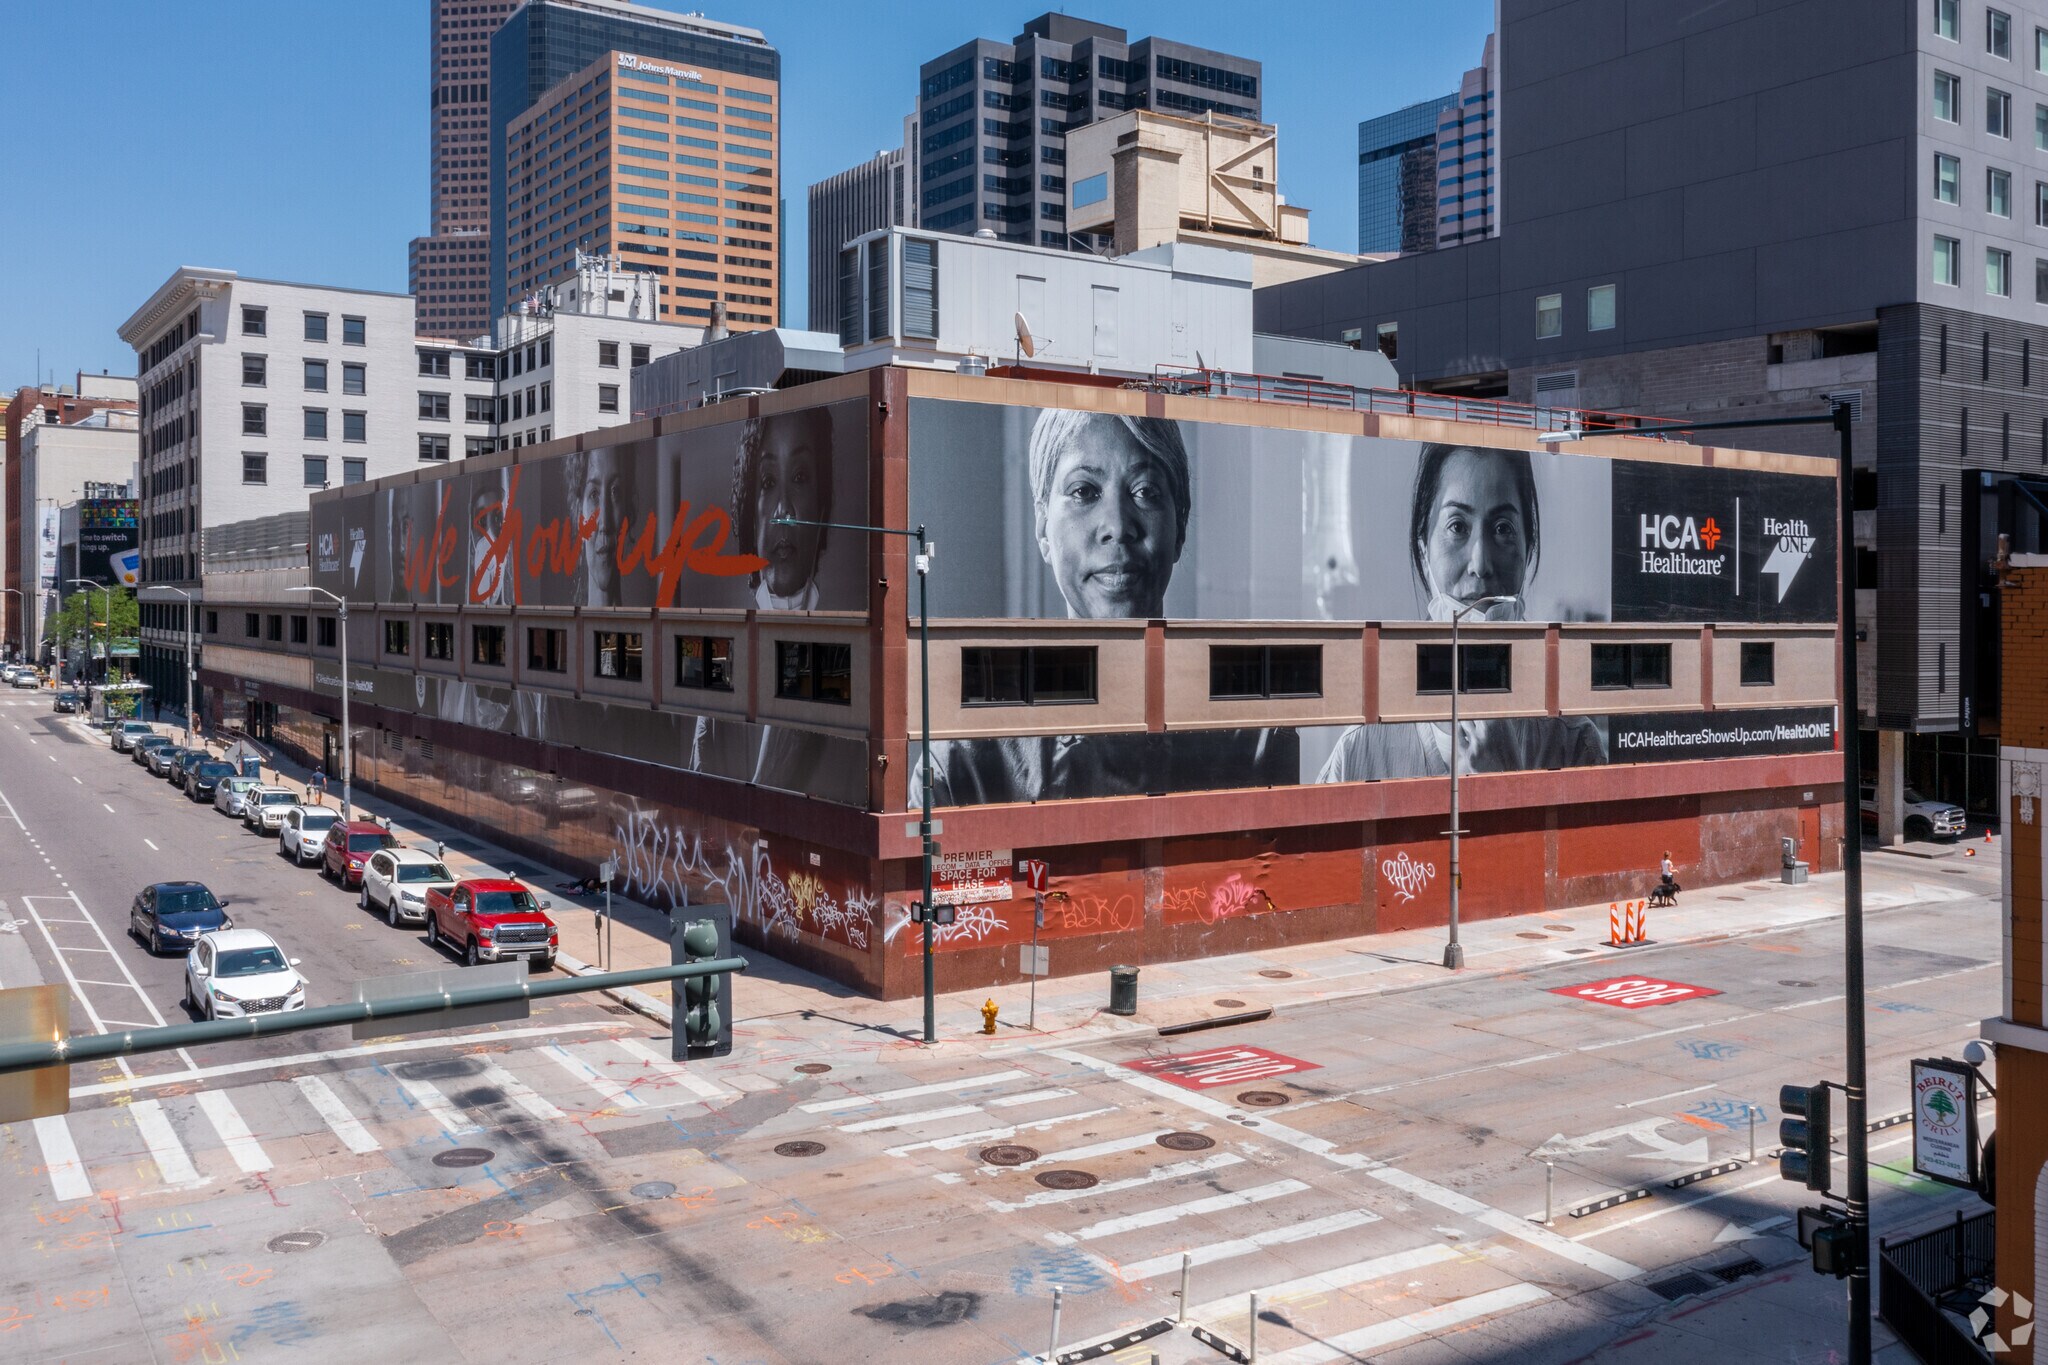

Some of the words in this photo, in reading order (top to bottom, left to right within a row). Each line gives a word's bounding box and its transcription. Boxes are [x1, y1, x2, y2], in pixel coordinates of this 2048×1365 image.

[638, 61, 664, 74] Johns
[665, 66, 702, 80] Manville
[1641, 514, 1700, 550] HCA
[1764, 518, 1809, 537] Health
[102, 533, 128, 541] switch
[319, 533, 334, 556] HCA
[943, 850, 993, 863] PREMIER
[932, 863, 957, 873] LECOM
[965, 862, 980, 871] DATA
[989, 859, 1011, 867] OFFICE
[940, 869, 972, 882] SPACE
[977, 868, 997, 878] FOR
[952, 879, 985, 890] LEASE
[1578, 980, 1694, 1004] BUS
[1917, 1077, 1965, 1101] BEIRUT
[1922, 1119, 1961, 1136] GRILL
